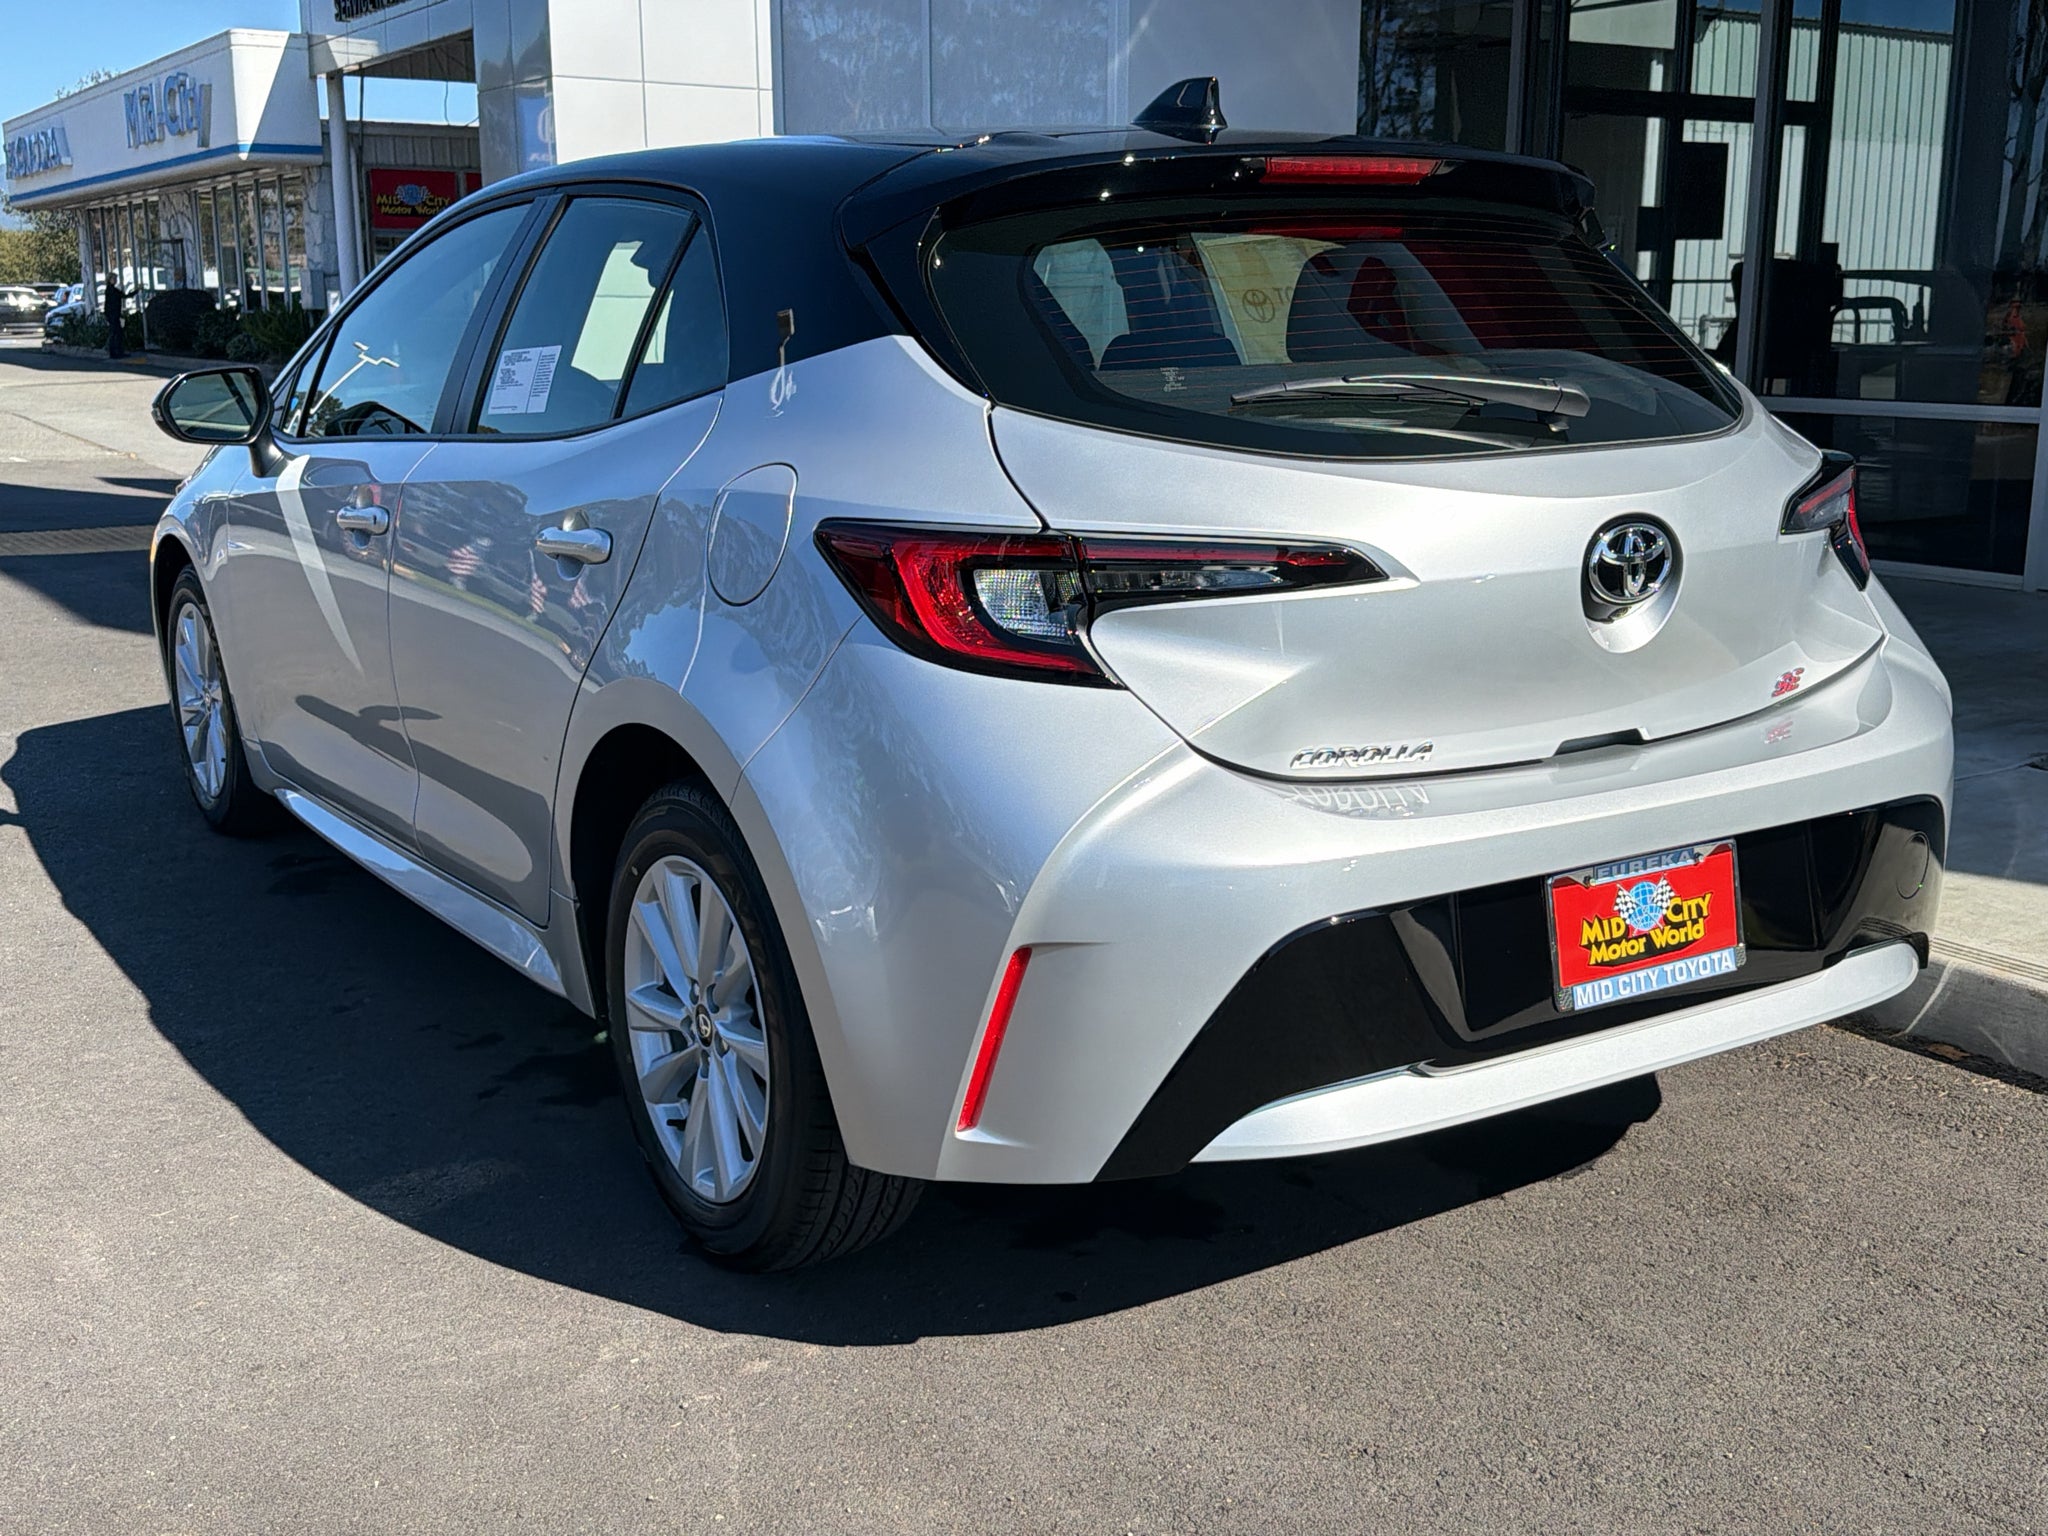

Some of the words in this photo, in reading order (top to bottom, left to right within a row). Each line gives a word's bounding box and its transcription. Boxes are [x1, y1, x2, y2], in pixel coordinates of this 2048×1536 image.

[381, 205, 411, 215] Motor
[415, 205, 441, 215] Worl
[425, 195, 450, 206] CITY
[1290, 739, 1434, 769] COROLLA
[1597, 850, 1692, 879] EUREKA
[1580, 917, 1626, 946] MID
[1667, 894, 1712, 922] CITY
[1589, 937, 1647, 965] Motor
[1650, 919, 1704, 948] World
[1576, 981, 1613, 1007] MID
[1618, 970, 1660, 994] CITY
[1665, 951, 1733, 981] TOYOTA
